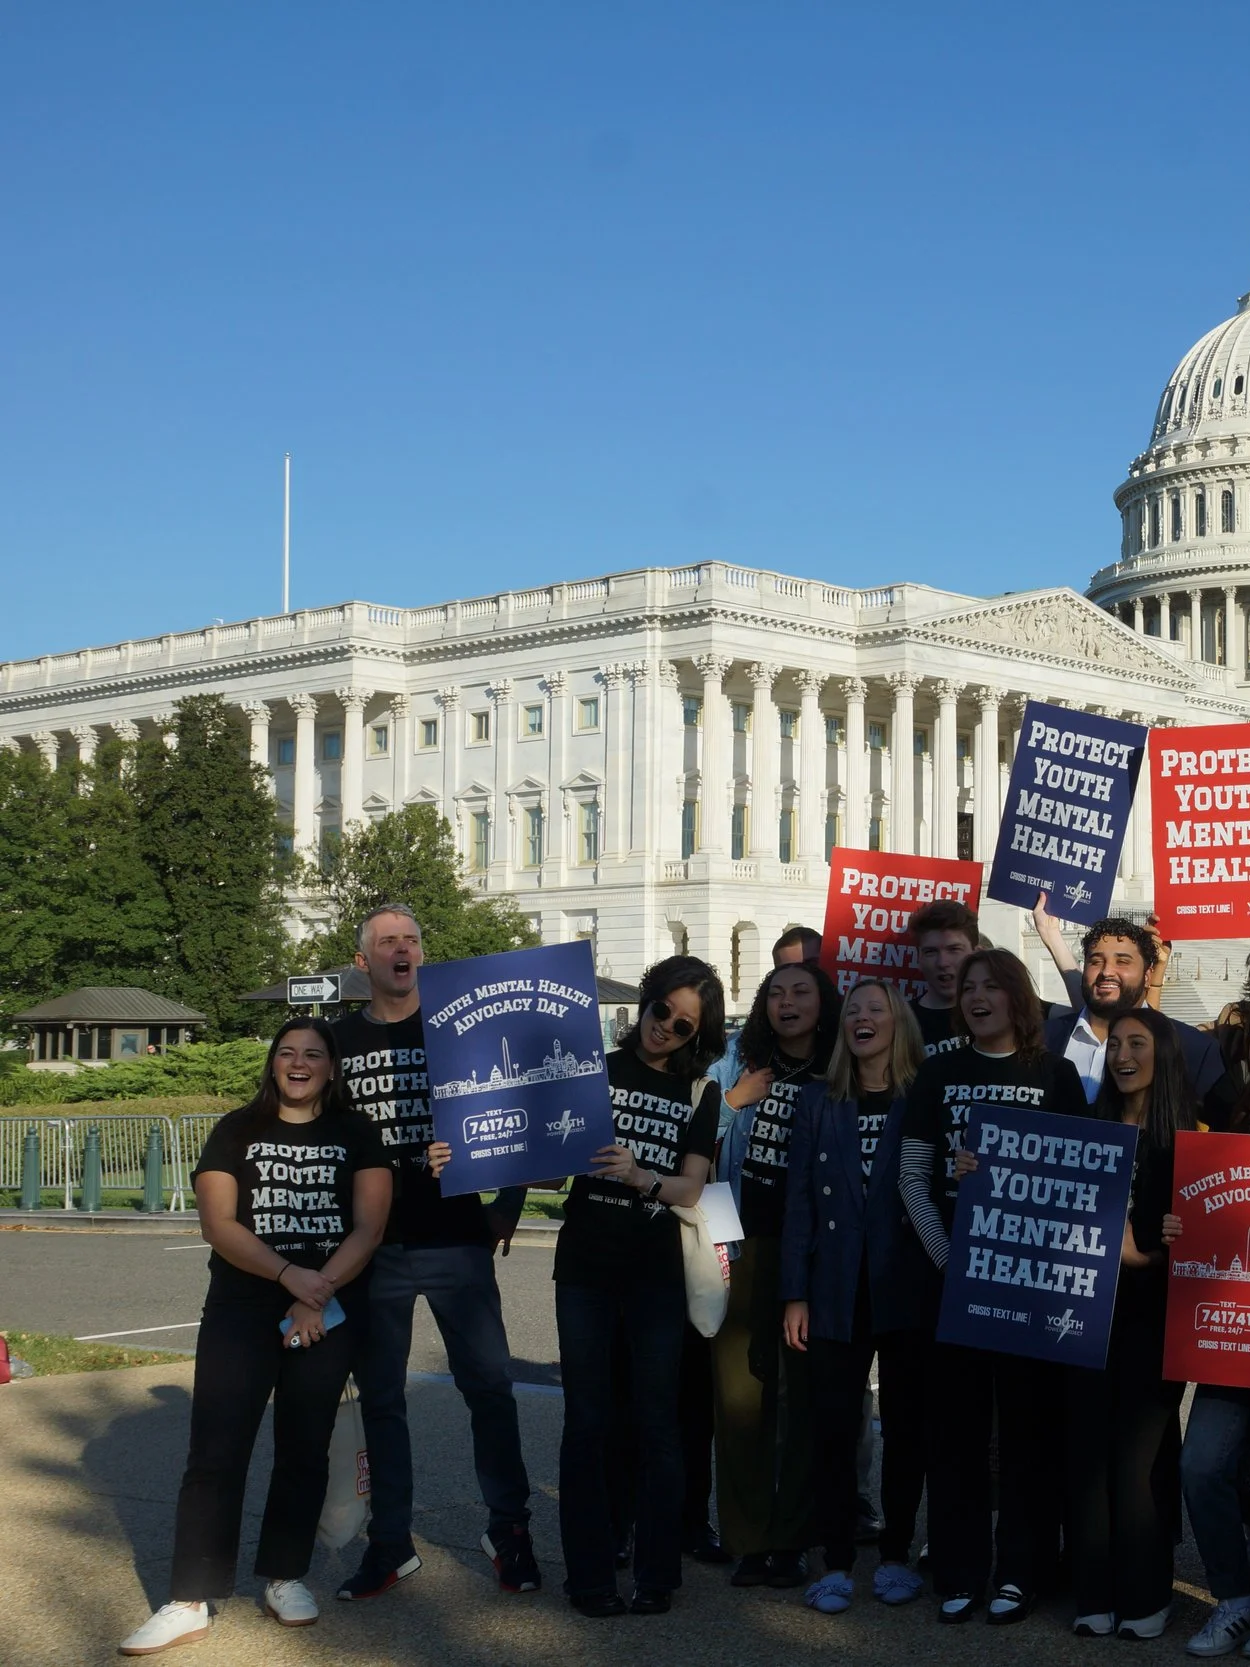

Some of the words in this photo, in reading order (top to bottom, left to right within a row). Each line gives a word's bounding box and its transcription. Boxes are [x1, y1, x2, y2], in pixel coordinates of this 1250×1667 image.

[1028, 720, 1134, 769] PROTECT
[1034, 757, 1114, 802] YOUTH
[1016, 790, 1114, 839] MENTAL
[1010, 824, 1106, 872] HEALTH
[840, 868, 970, 906] PROTECT
[1010, 871, 1026, 882] CRISIS
[1027, 876, 1040, 886] TEXT
[1040, 880, 1052, 890] LINE
[1065, 885, 1092, 900] YOUTH
[852, 903, 911, 933] YOU
[1176, 906, 1197, 914] CRISIS
[1198, 904, 1215, 914] TEXT
[1216, 904, 1230, 913] LINE
[836, 936, 920, 968] MENT
[294, 985, 308, 996] ONE
[311, 984, 324, 994] WAY
[837, 970, 928, 1000] HLT
[428, 994, 473, 1028] YOUTH
[475, 980, 534, 1000] MENTAL
[538, 980, 592, 1008] HEALTH
[454, 998, 533, 1036] ADVOCACY
[536, 998, 569, 1018] DAY
[341, 1048, 425, 1076] PROTEC
[347, 1072, 428, 1099] YOUTH
[943, 1084, 1044, 1106] PROTECT
[349, 1098, 432, 1121] ENTA
[382, 1123, 436, 1146] ALTH
[470, 1115, 520, 1134] 741741
[498, 1129, 512, 1138] 24/7
[545, 1117, 584, 1131] YOUTH
[245, 1142, 346, 1162] PROTECT
[471, 1149, 491, 1159] CRISIS
[492, 1146, 509, 1156] TEXT
[510, 1143, 525, 1152] LINE
[615, 1137, 678, 1170] NTAL
[746, 1144, 789, 1167] EAL
[977, 1123, 1123, 1174] PROTECT
[256, 1160, 336, 1185] YOUTH
[989, 1166, 1100, 1212] YOUTH
[1179, 1171, 1226, 1200] YOUTH
[604, 1196, 618, 1204] TEXT
[253, 1213, 344, 1234] HEALTH
[968, 1206, 1106, 1256] MENTAL
[966, 1246, 1098, 1298] HEALTH
[968, 1304, 990, 1316] CRISIS
[992, 1308, 1011, 1320] TEXT
[1012, 1311, 1028, 1323] LINE
[1047, 1315, 1084, 1330] YOUTH
[1210, 1326, 1226, 1334] FREE,
[1228, 1326, 1243, 1335] 24/7
[1198, 1340, 1218, 1350] CRISIS
[1220, 1342, 1237, 1351] TEXT
